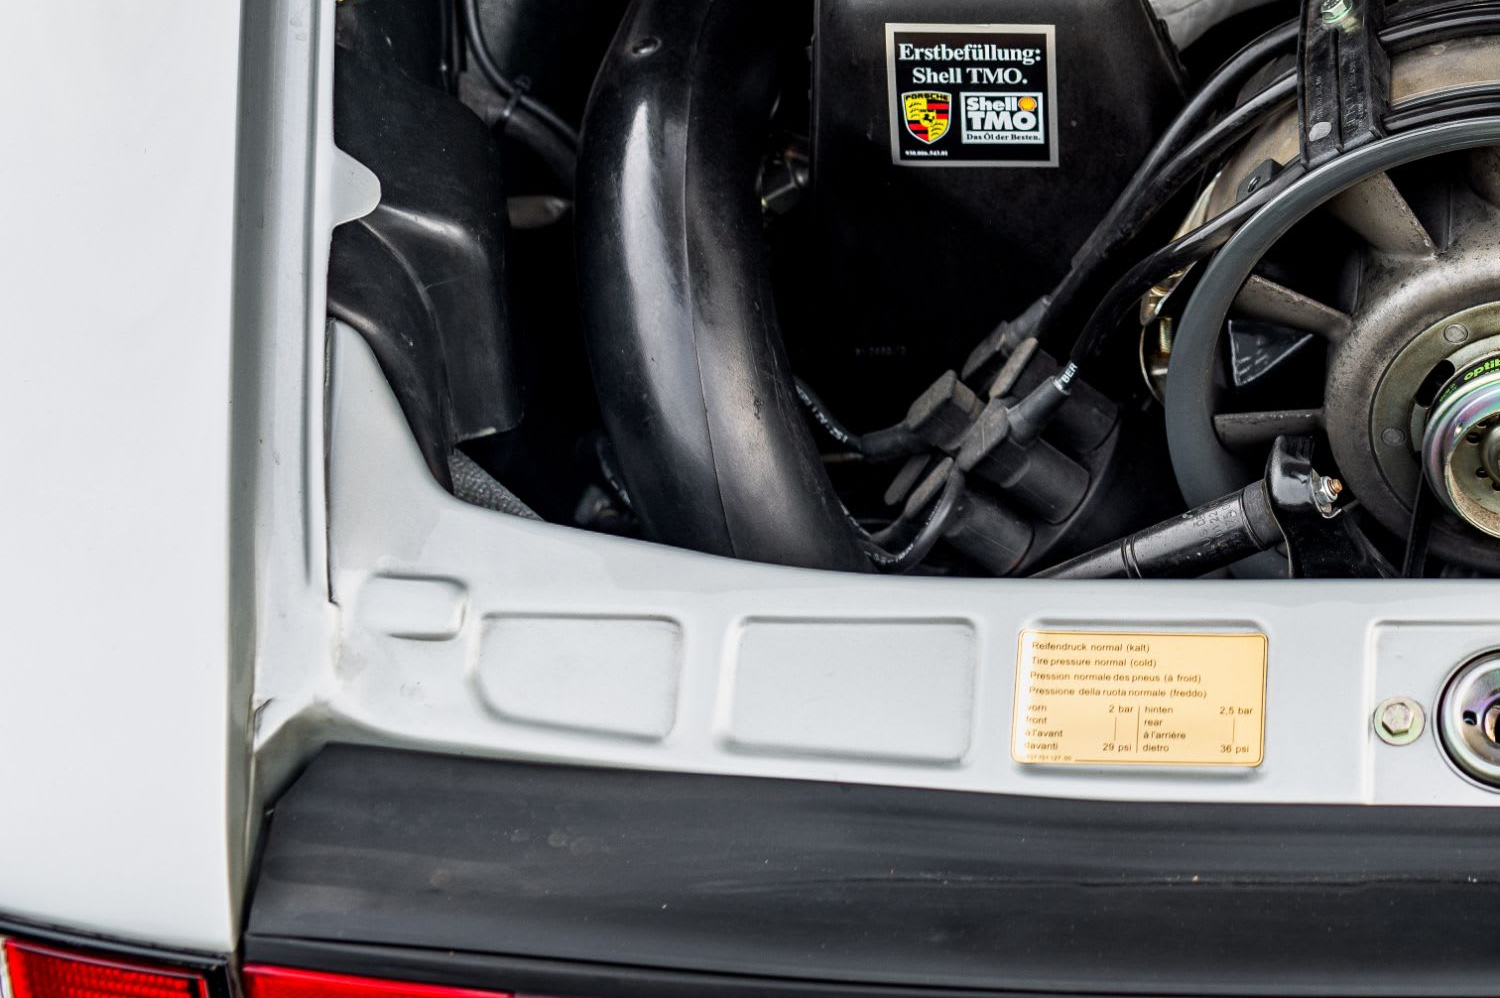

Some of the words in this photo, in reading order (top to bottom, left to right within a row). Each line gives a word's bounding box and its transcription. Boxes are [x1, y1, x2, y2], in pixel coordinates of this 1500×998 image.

[898, 43, 1041, 65] Erstbefüllung:
[912, 67, 963, 84] Shell
[966, 67, 1028, 84] TMO.
[905, 92, 949, 101] PORSCHE
[966, 96, 1017, 111] Shell
[967, 110, 1037, 130] TMO
[983, 132, 994, 141] Öl
[1061, 362, 1078, 383] BER
[1032, 641, 1087, 651] Reifendruck
[1091, 643, 1123, 652] normal
[1126, 643, 1150, 653] (kalt)
[1033, 656, 1048, 665] Tire
[1050, 658, 1091, 666] pressure
[1094, 658, 1127, 666] normal
[1130, 658, 1157, 668] (cold)
[1030, 671, 1070, 680] Pression
[1073, 673, 1111, 681] normale
[1113, 673, 1130, 681] des
[1131, 674, 1161, 683] pneus
[1176, 673, 1201, 683] froid)
[1029, 686, 1075, 696] Pressione
[1078, 687, 1101, 696] della
[1102, 688, 1127, 696] ruota
[1128, 689, 1166, 697] normale
[1169, 689, 1207, 699] (freddo)
[1108, 704, 1115, 713] 2
[1118, 704, 1133, 713] bar
[1144, 705, 1174, 713] hinten
[1237, 706, 1253, 715] bar
[1026, 715, 1048, 724] front
[1144, 718, 1163, 727] rear
[1024, 742, 1059, 750] davanti
[1102, 743, 1115, 752] 29
[1118, 743, 1132, 752] psi
[1142, 743, 1170, 752] dietro
[1220, 744, 1232, 753] 36
[1235, 744, 1249, 754] psi
